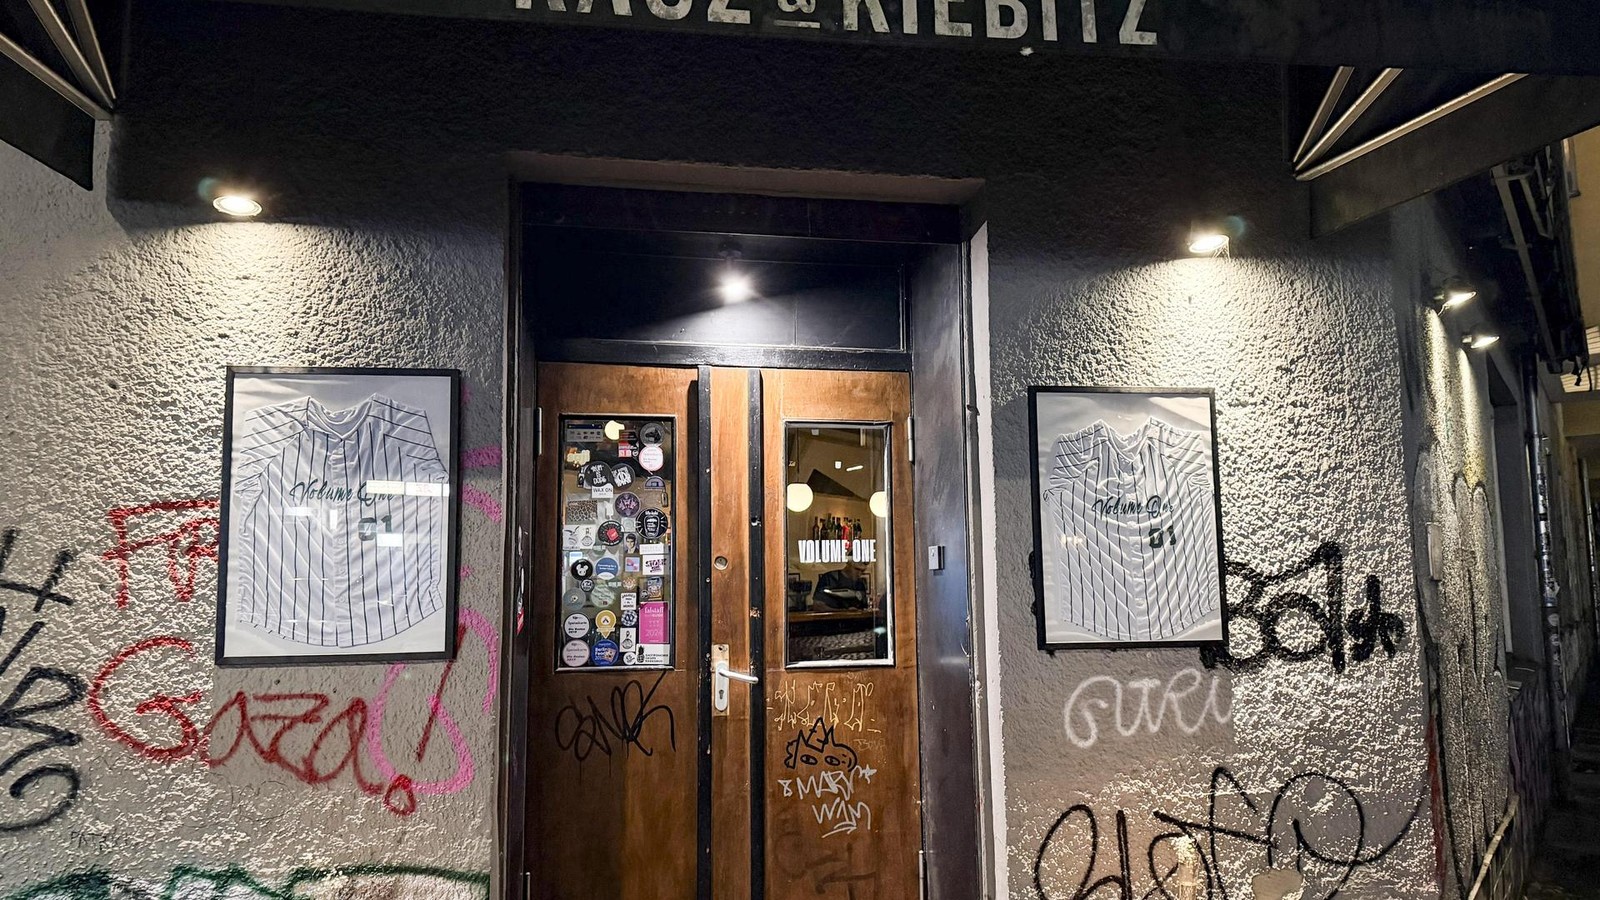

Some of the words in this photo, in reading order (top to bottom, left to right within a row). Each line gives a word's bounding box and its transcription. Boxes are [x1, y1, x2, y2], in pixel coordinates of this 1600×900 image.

[289, 478, 353, 503] Volume
[1091, 496, 1143, 521] Volume
[1147, 524, 1177, 549] 01
[797, 539, 849, 564] VOLUME
[851, 539, 877, 563] ONE
